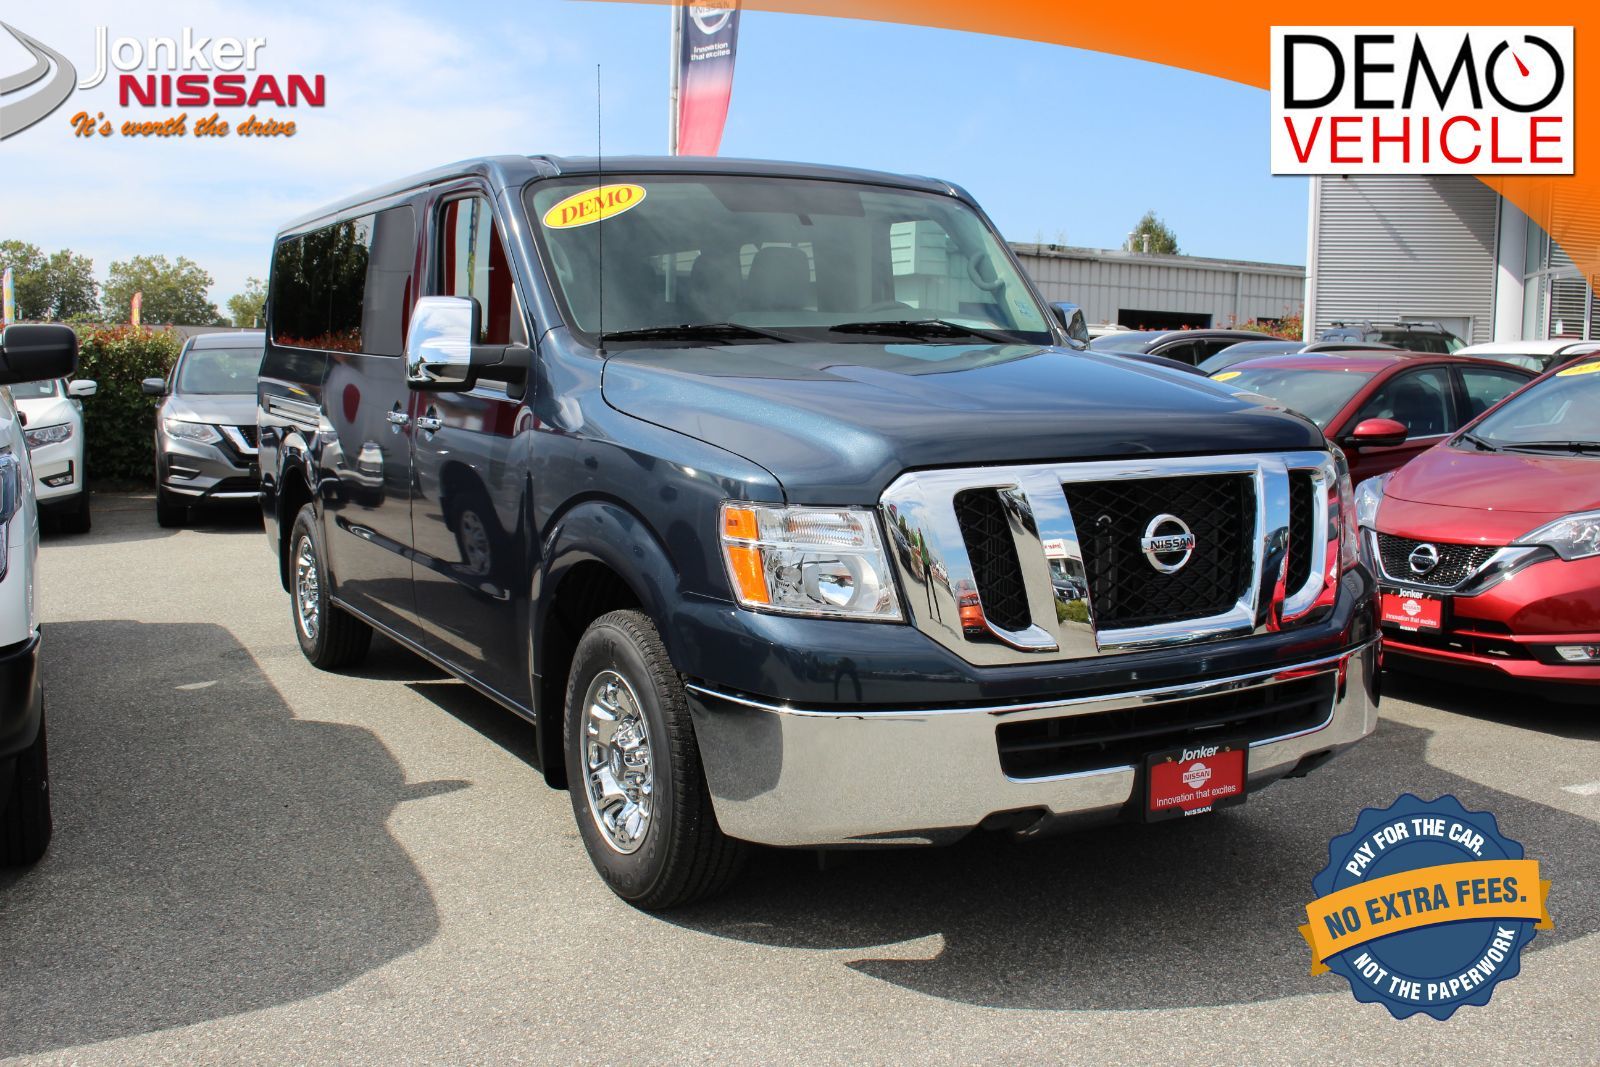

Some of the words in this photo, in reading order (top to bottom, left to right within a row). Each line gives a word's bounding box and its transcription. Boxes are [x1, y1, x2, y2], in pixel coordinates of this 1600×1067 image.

[706, 50, 730, 58] excites
[562, 187, 632, 224] DEMO
[1150, 537, 1194, 549] NISSAN
[1399, 588, 1423, 599] Jonker
[1178, 746, 1219, 764] Jonker
[1184, 771, 1210, 780] NISSAN
[1156, 792, 1194, 807] Innovation
[1196, 789, 1210, 799] that
[1212, 784, 1236, 796] excites
[1184, 806, 1212, 816] NISSAN
